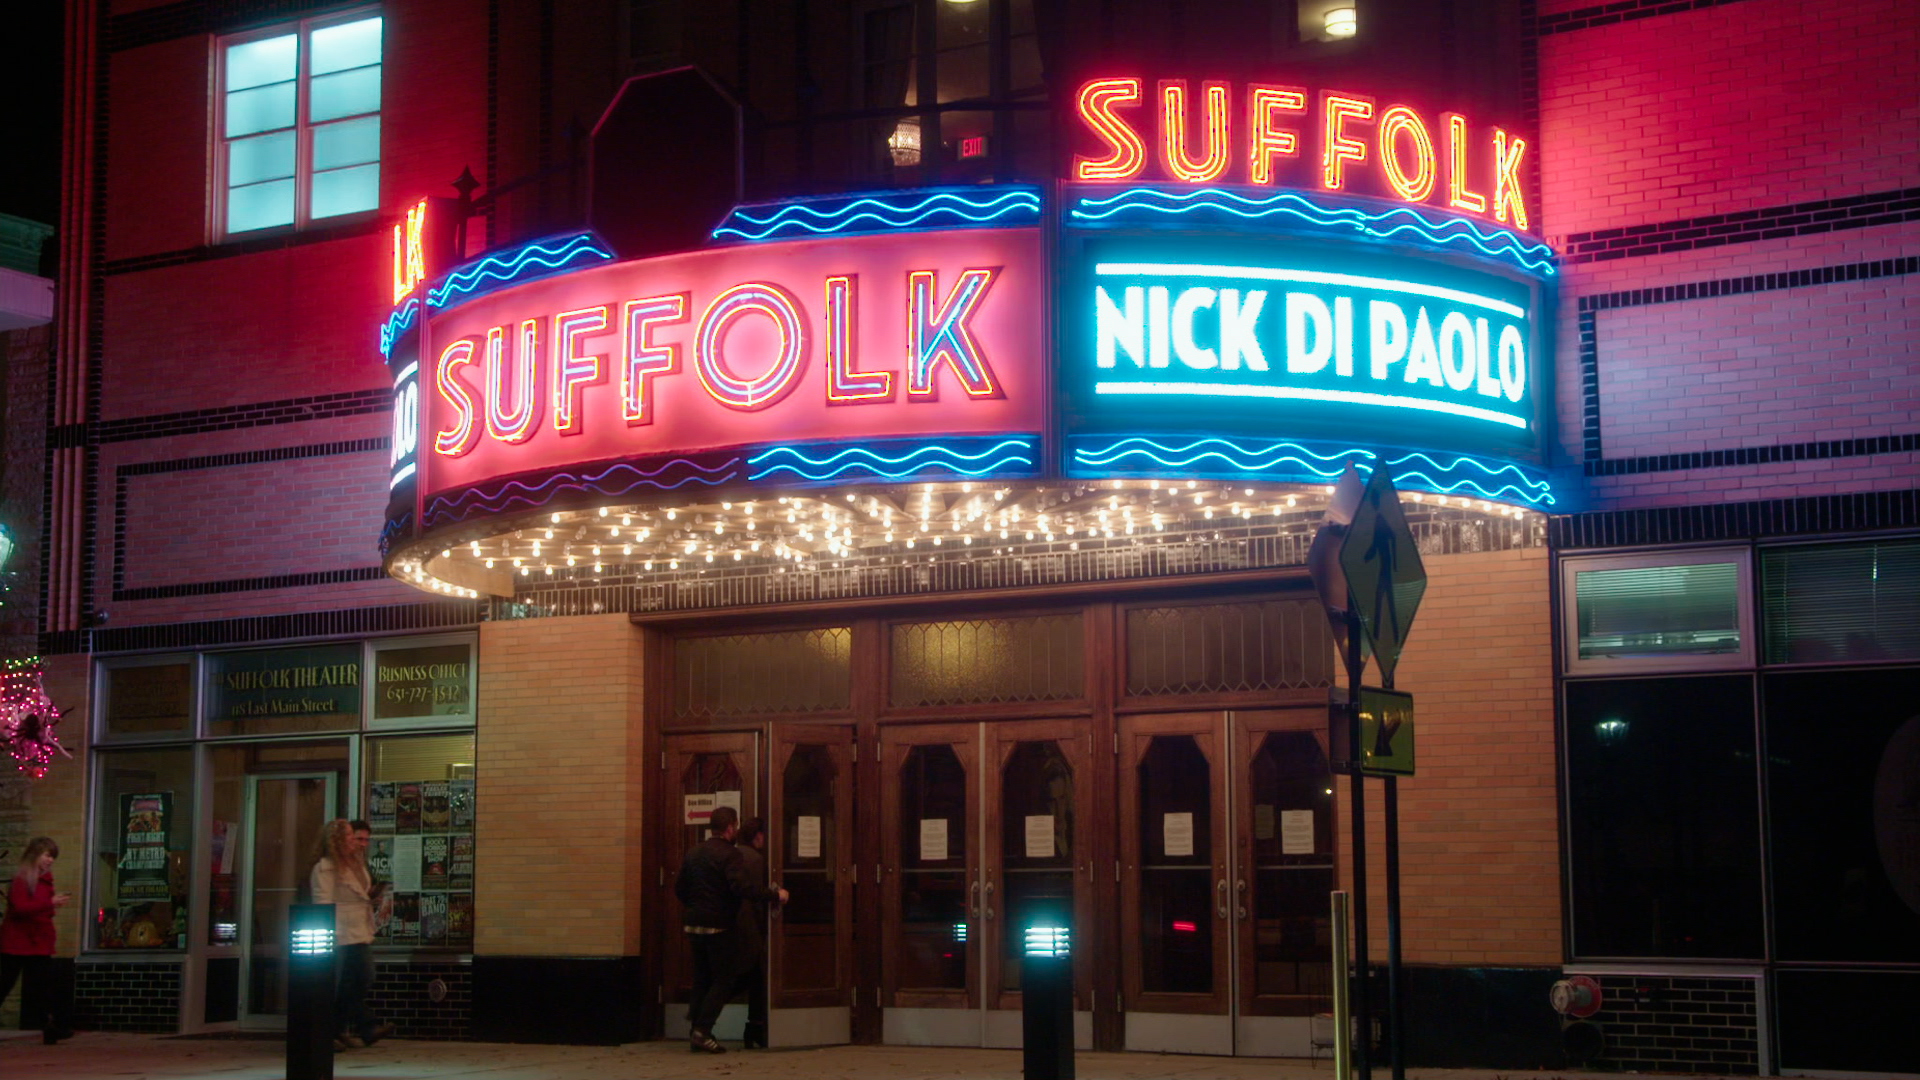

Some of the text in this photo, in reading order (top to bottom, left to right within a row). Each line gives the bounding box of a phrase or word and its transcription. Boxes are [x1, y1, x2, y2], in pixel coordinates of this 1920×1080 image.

[962, 137, 983, 157] EXIT
[1074, 77, 1529, 232] SUFFOLK
[1095, 285, 1527, 403] NICK DI PAOLO
[434, 266, 1005, 457] SUFFOLK
[227, 669, 291, 690] SUFFOLK
[293, 663, 358, 687] THEATER
[378, 664, 427, 683] BUSINESS
[270, 698, 299, 713] Main
[301, 697, 335, 712] Street
